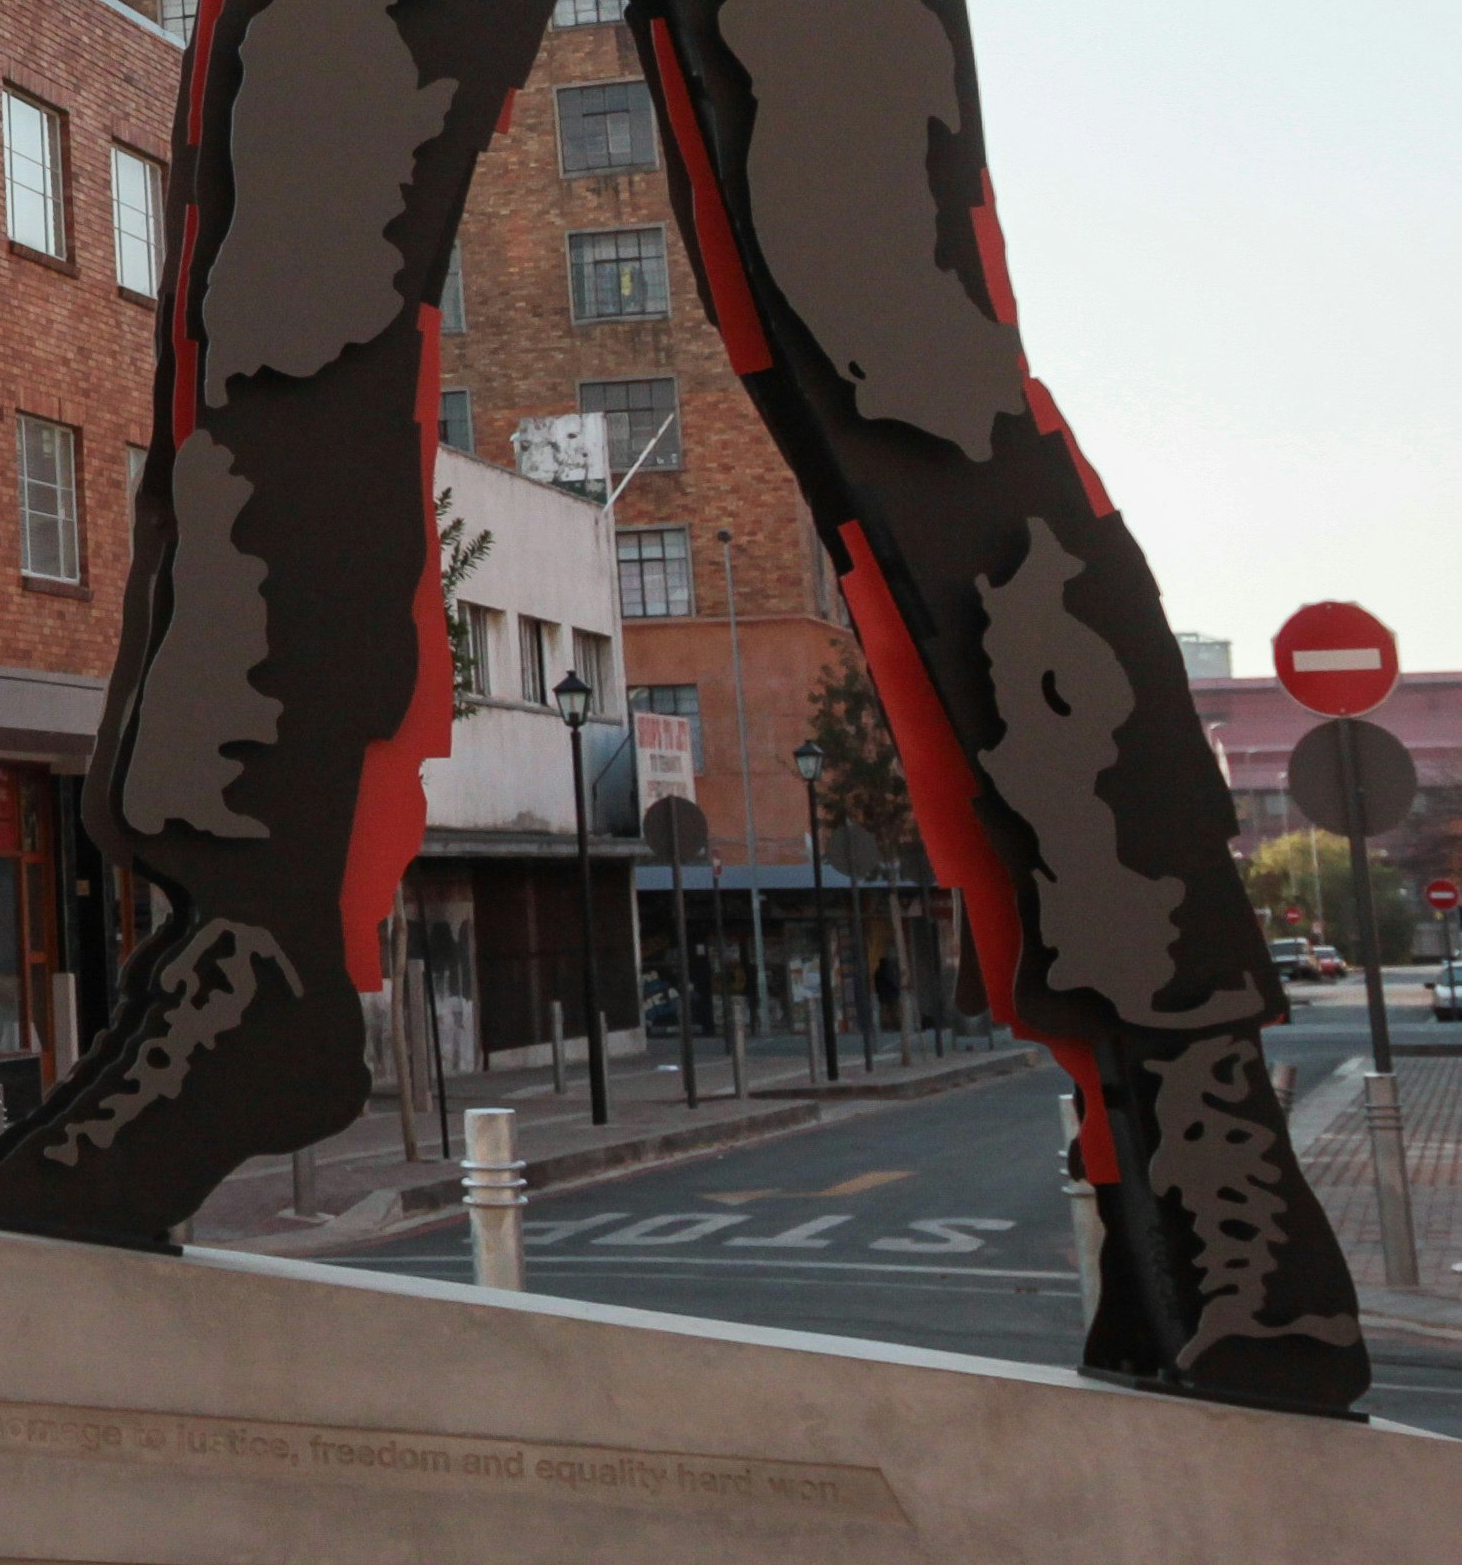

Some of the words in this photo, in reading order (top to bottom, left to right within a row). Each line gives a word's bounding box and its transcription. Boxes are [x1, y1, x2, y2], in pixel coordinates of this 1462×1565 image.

[135, 1419, 167, 1449] to
[309, 1434, 451, 1473] freedom
[463, 1451, 524, 1478] and
[535, 1456, 667, 1496] equality
[676, 1462, 753, 1495] hard
